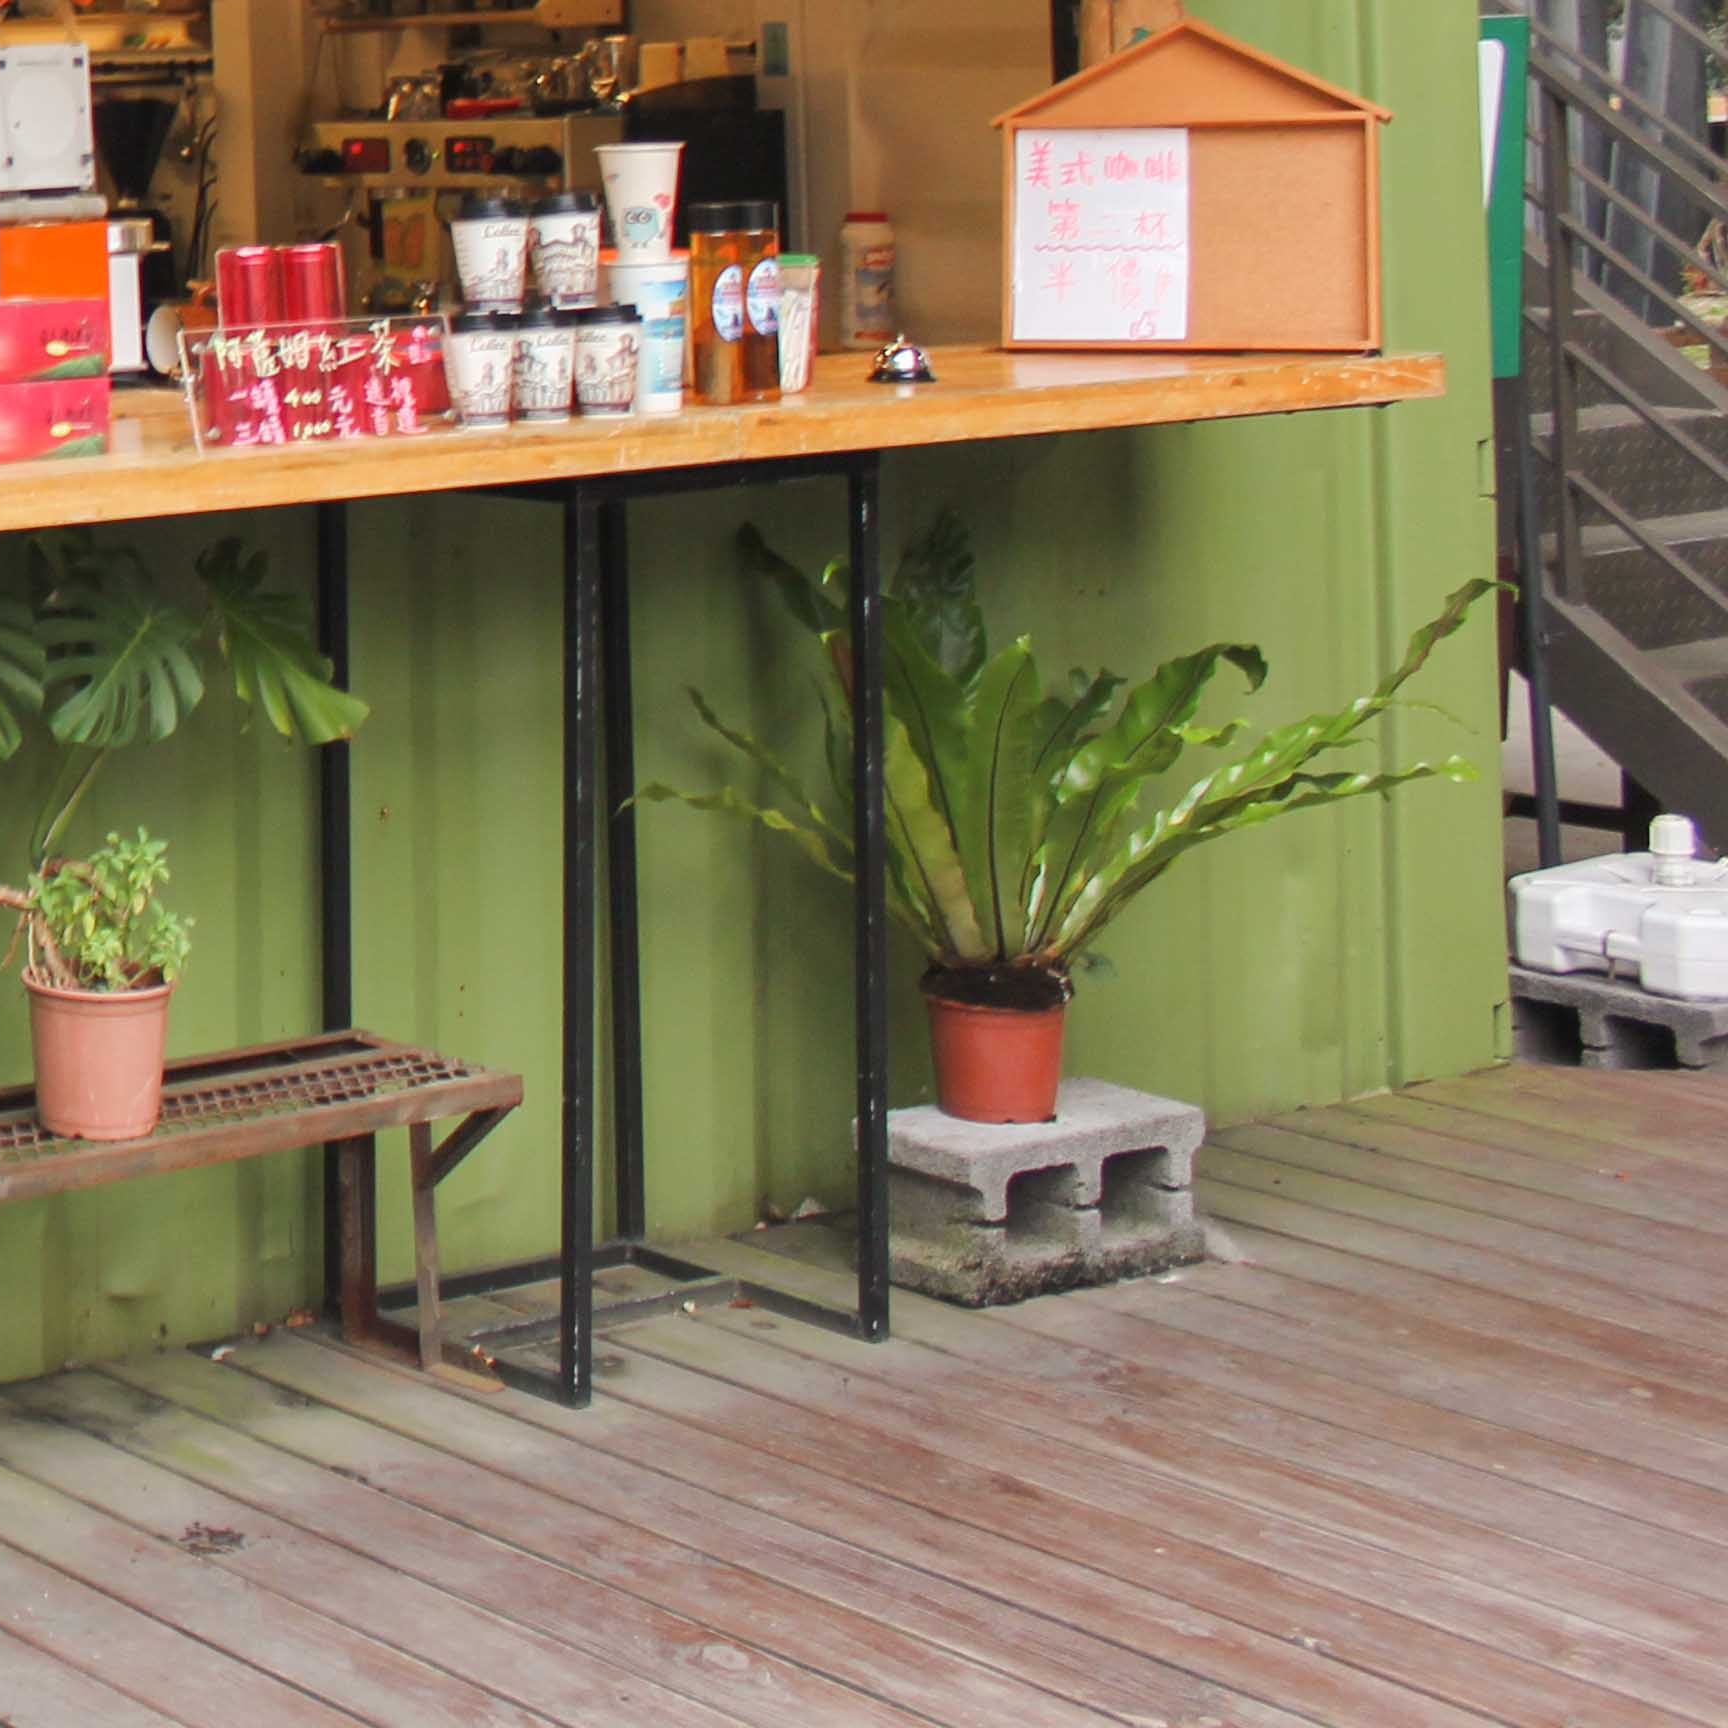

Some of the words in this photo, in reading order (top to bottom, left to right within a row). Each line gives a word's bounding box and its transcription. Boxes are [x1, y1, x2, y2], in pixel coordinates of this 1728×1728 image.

[1024, 138, 1181, 190] 美式咖啡
[1047, 198, 1170, 241] 第二杯
